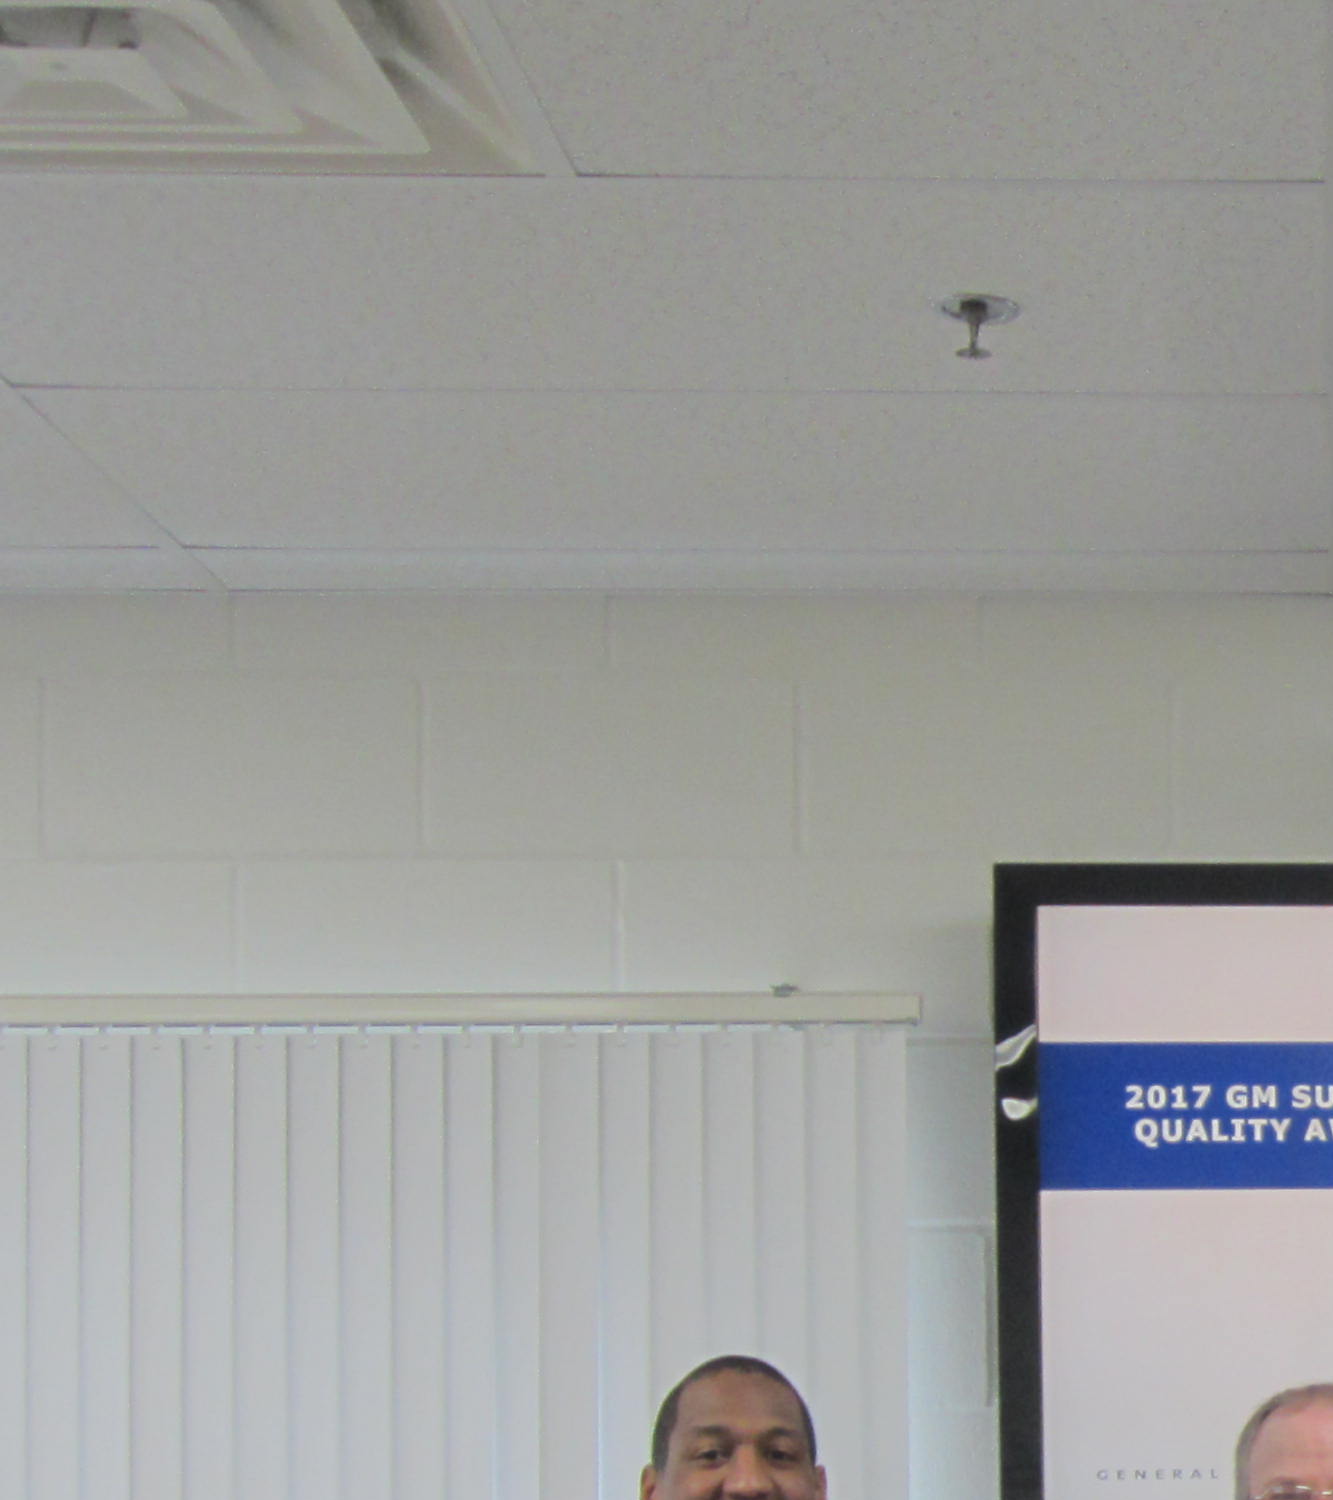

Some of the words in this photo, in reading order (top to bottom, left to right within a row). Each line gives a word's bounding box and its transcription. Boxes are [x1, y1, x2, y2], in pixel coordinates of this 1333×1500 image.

[1124, 1085, 1212, 1109] 2017
[1226, 1085, 1277, 1108] GM
[1134, 1118, 1291, 1147] QUALITY
[1096, 1468, 1219, 1481] GENERAL
